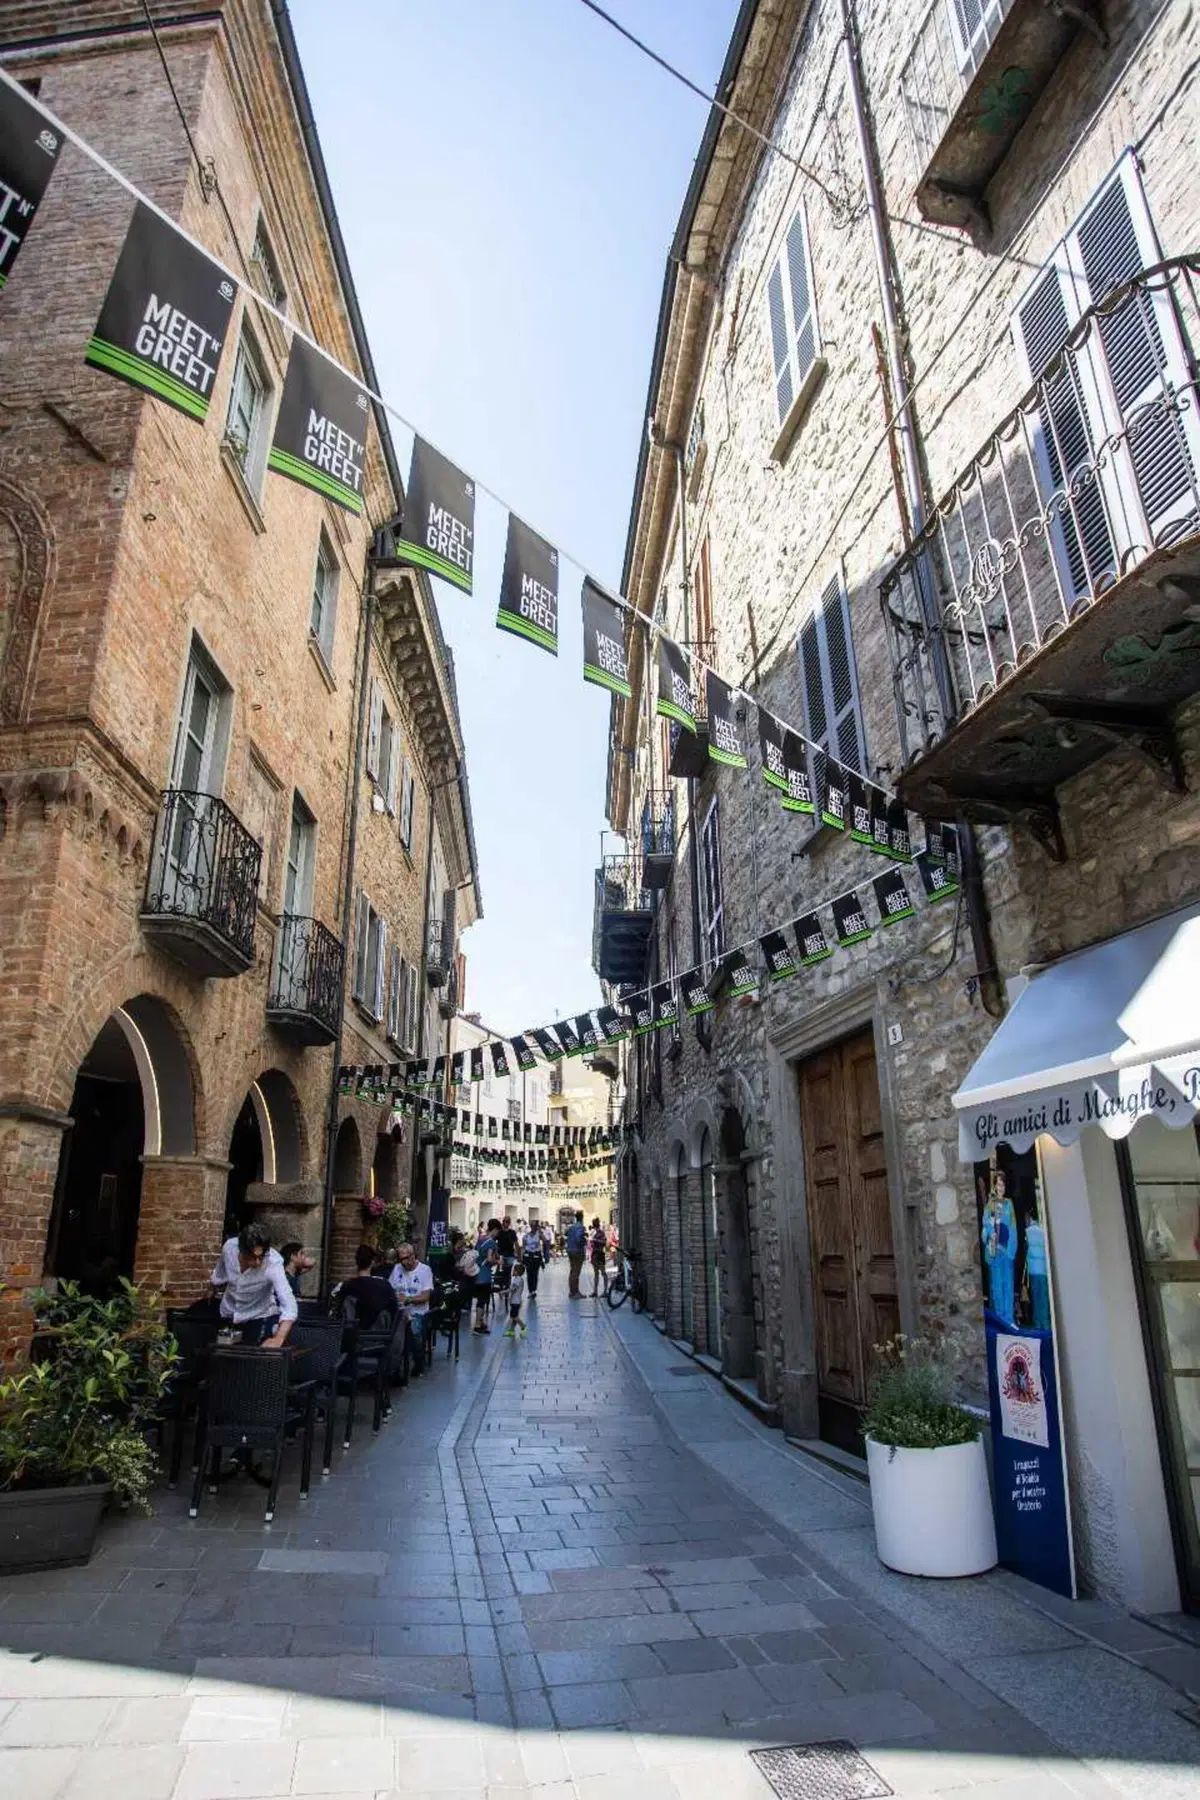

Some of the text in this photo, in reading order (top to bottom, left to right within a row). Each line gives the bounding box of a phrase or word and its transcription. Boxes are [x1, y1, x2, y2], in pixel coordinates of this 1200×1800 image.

[143, 293, 212, 358] MEET
[135, 324, 216, 393] GREET
[308, 408, 357, 461] MEET
[304, 435, 363, 490] GREET
[426, 525, 472, 571] GREET
[428, 501, 467, 545] MEET
[520, 595, 557, 634] GREET
[521, 572, 555, 610] MEET
[975, 1114, 998, 1149] Gli
[1003, 1105, 1048, 1135] amici
[1053, 1097, 1071, 1127] di
